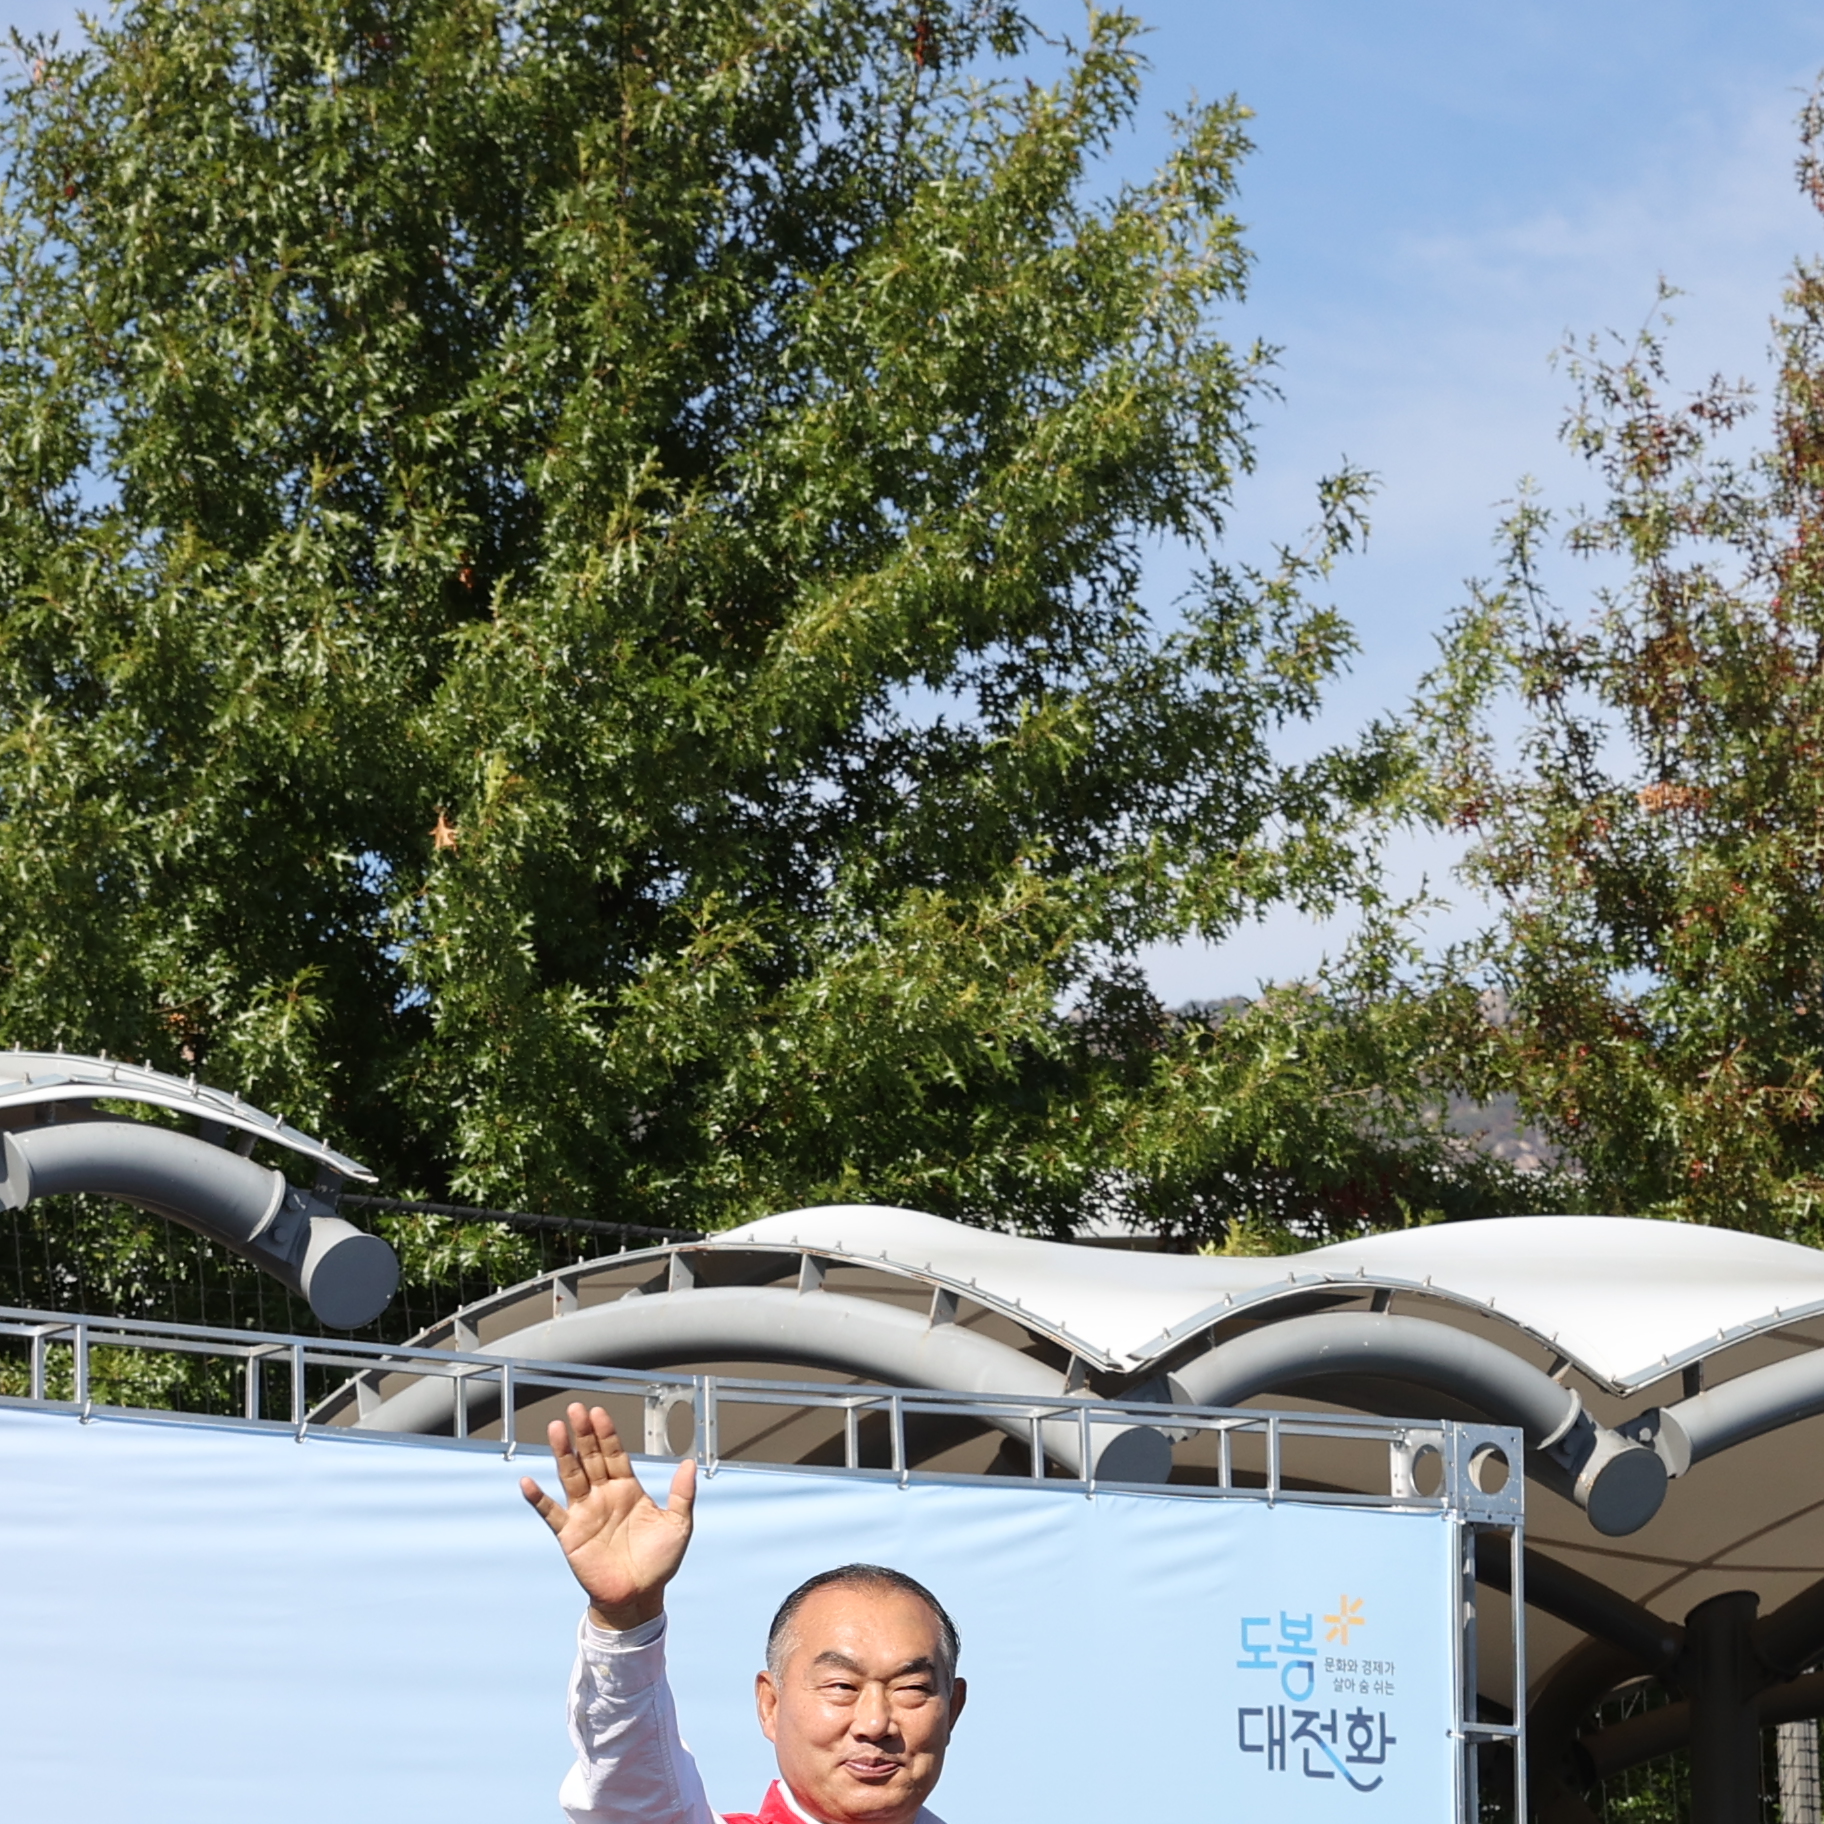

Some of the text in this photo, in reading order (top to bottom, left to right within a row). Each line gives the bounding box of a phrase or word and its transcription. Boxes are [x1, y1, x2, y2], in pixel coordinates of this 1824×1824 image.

[1236, 1611, 1318, 1702] 도봉
[1324, 1657, 1395, 1677] 문화와 경제가
[1333, 1677, 1395, 1696] 살아 숨 쉬는
[1237, 1704, 1397, 1793] 대전환
